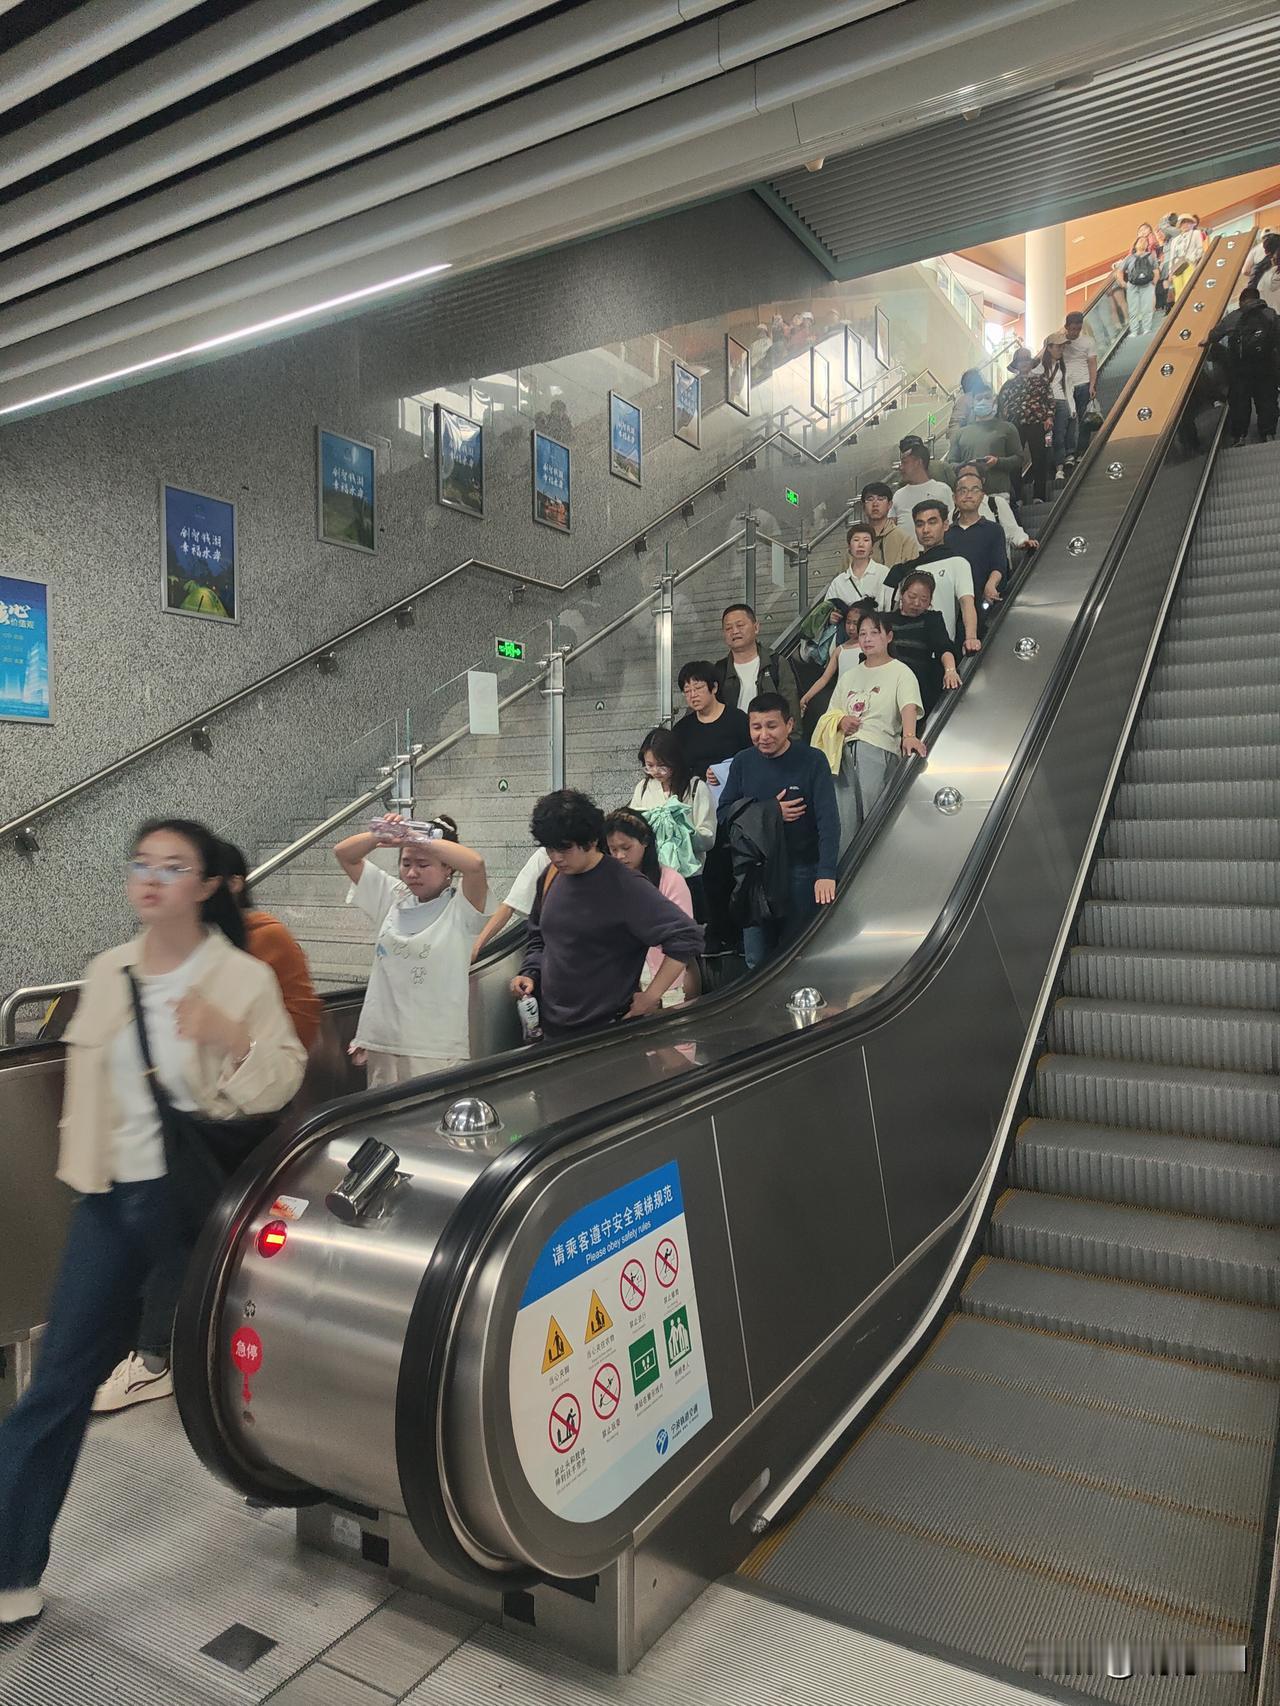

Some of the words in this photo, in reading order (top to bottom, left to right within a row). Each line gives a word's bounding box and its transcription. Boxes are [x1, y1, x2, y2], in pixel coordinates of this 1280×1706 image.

[180, 526, 222, 548] 创智钱湖
[180, 541, 222, 563] 幸福水岸
[552, 1184, 674, 1267] 请乘客遵守安全乘梯规范
[586, 1247, 607, 1265] Please
[607, 1238, 621, 1255] obey
[621, 1228, 639, 1247] safety
[638, 1220, 652, 1237] rules
[235, 1340, 258, 1361] 急停
[671, 1402, 698, 1434] 宁波轨道交通
